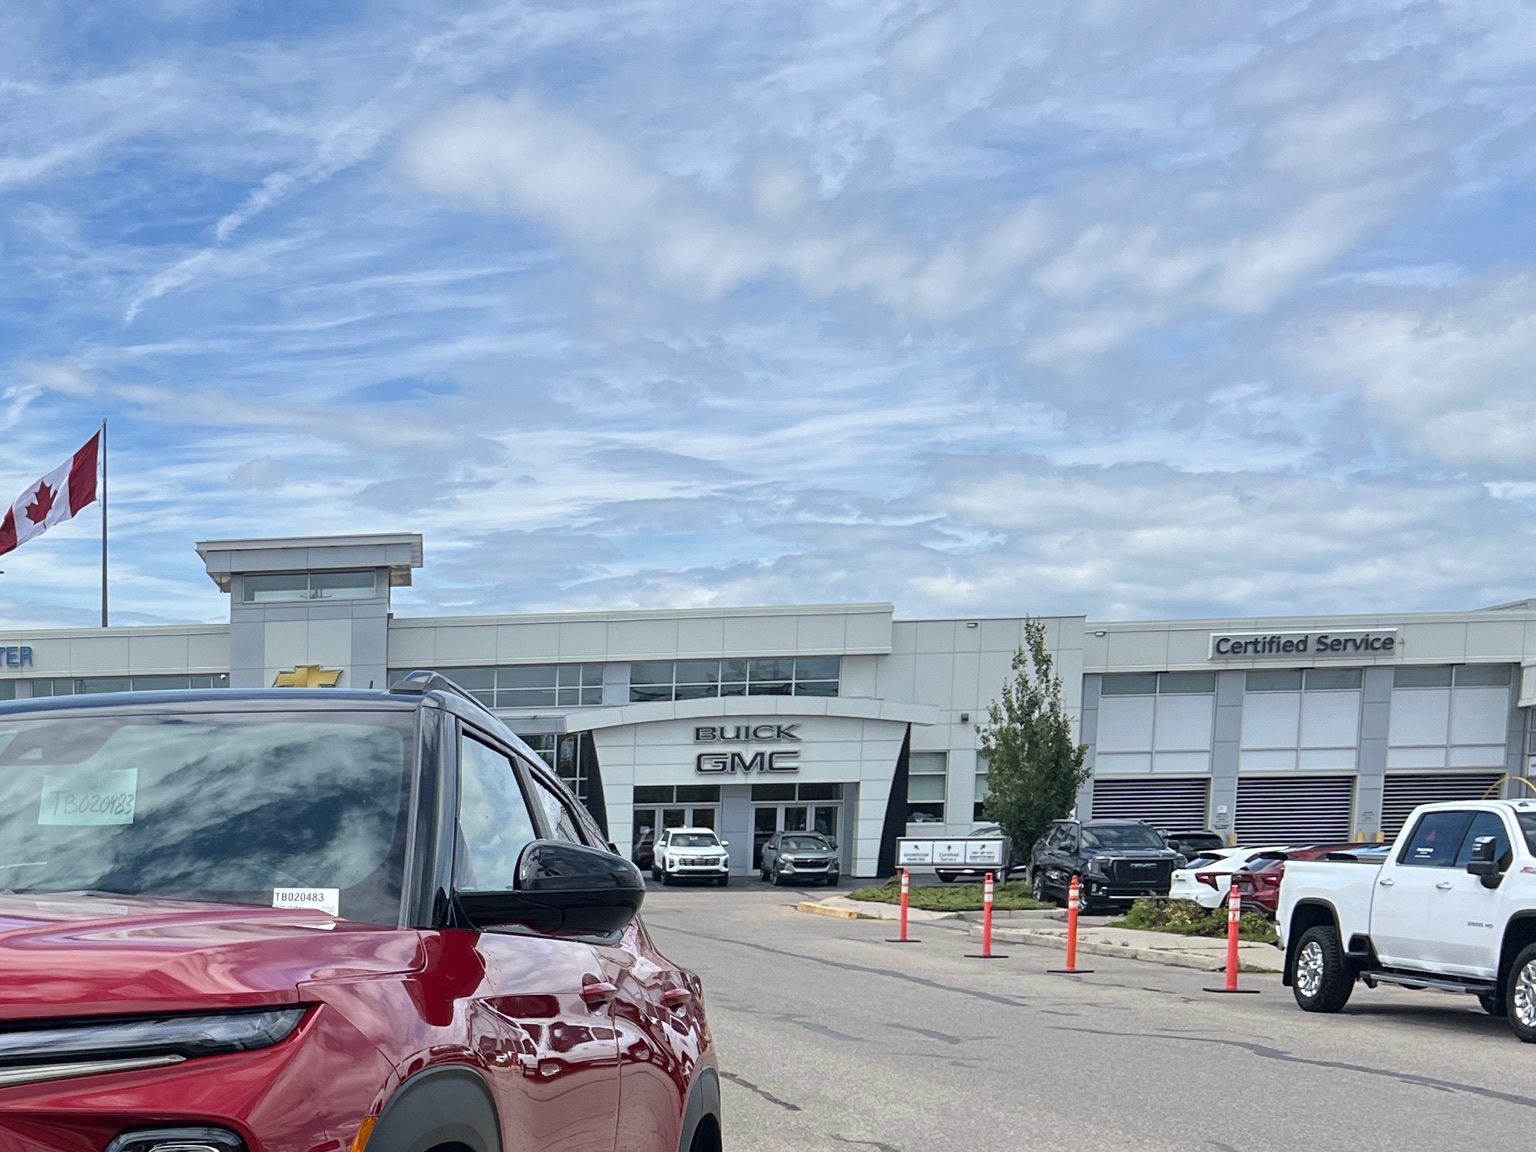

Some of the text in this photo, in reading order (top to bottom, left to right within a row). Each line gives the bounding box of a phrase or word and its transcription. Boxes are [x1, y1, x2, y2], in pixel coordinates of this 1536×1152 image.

[1216, 633, 1395, 655] Certified Service
[694, 724, 802, 743] BUICK
[695, 749, 801, 776] GMC
[275, 892, 324, 902] TB020483
